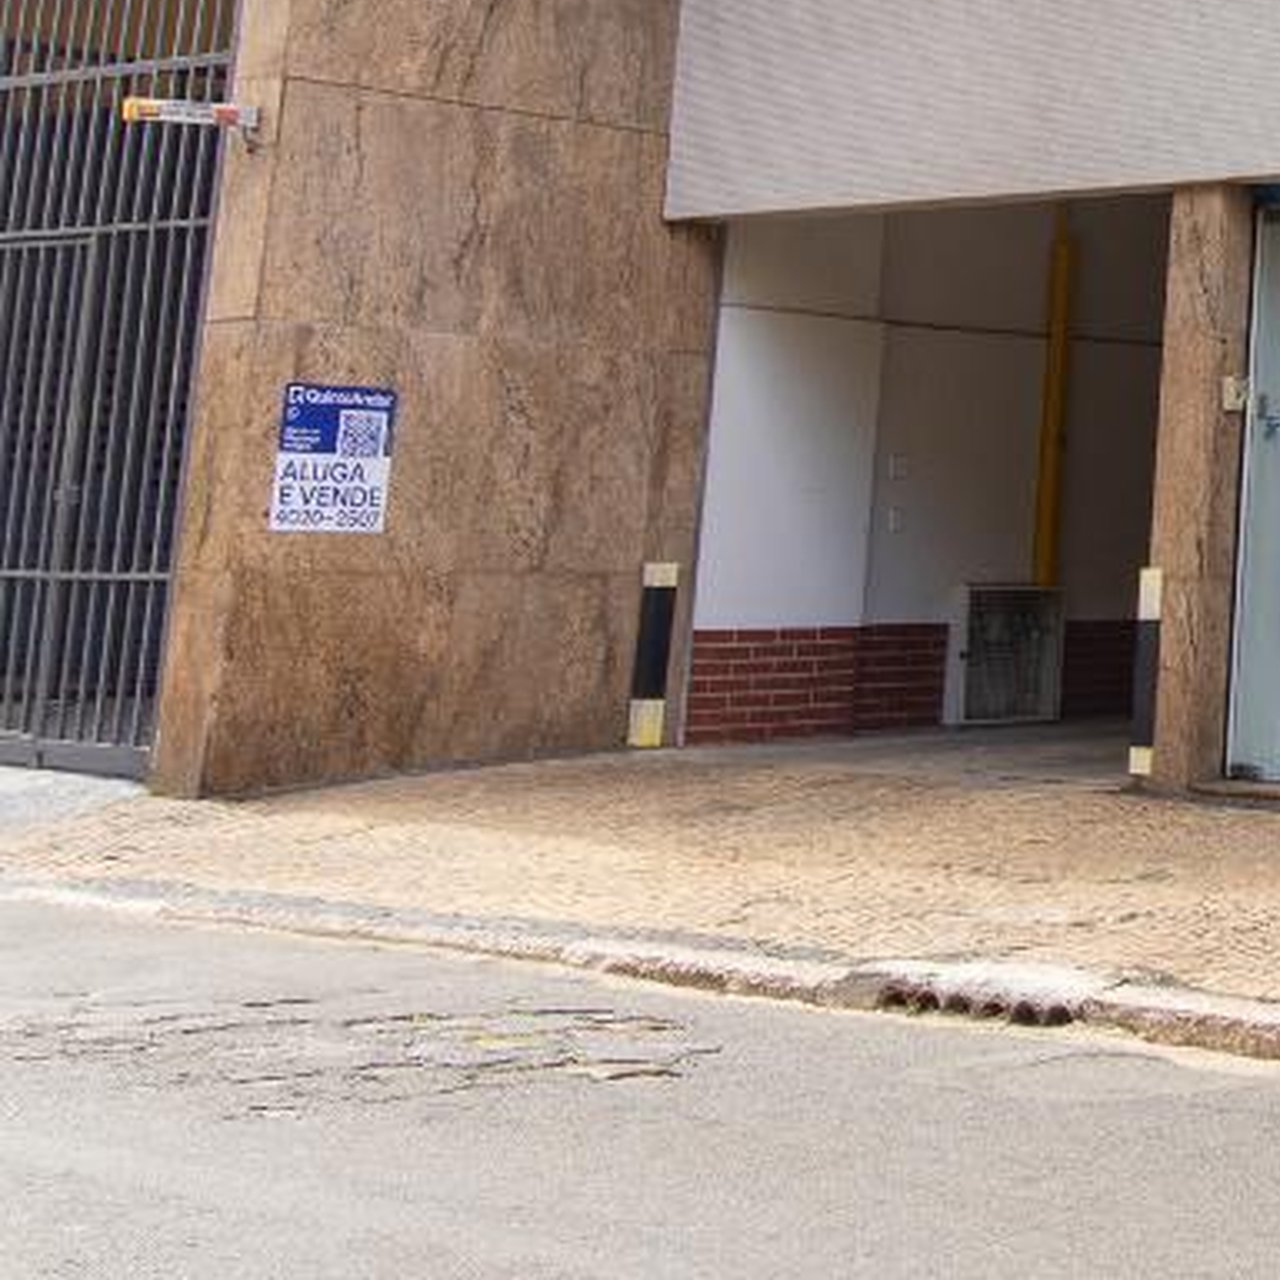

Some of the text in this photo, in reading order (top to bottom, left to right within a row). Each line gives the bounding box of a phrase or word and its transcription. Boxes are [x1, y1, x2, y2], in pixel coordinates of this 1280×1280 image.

[279, 460, 366, 483] ALUGA
[279, 485, 382, 508] E VENDE
